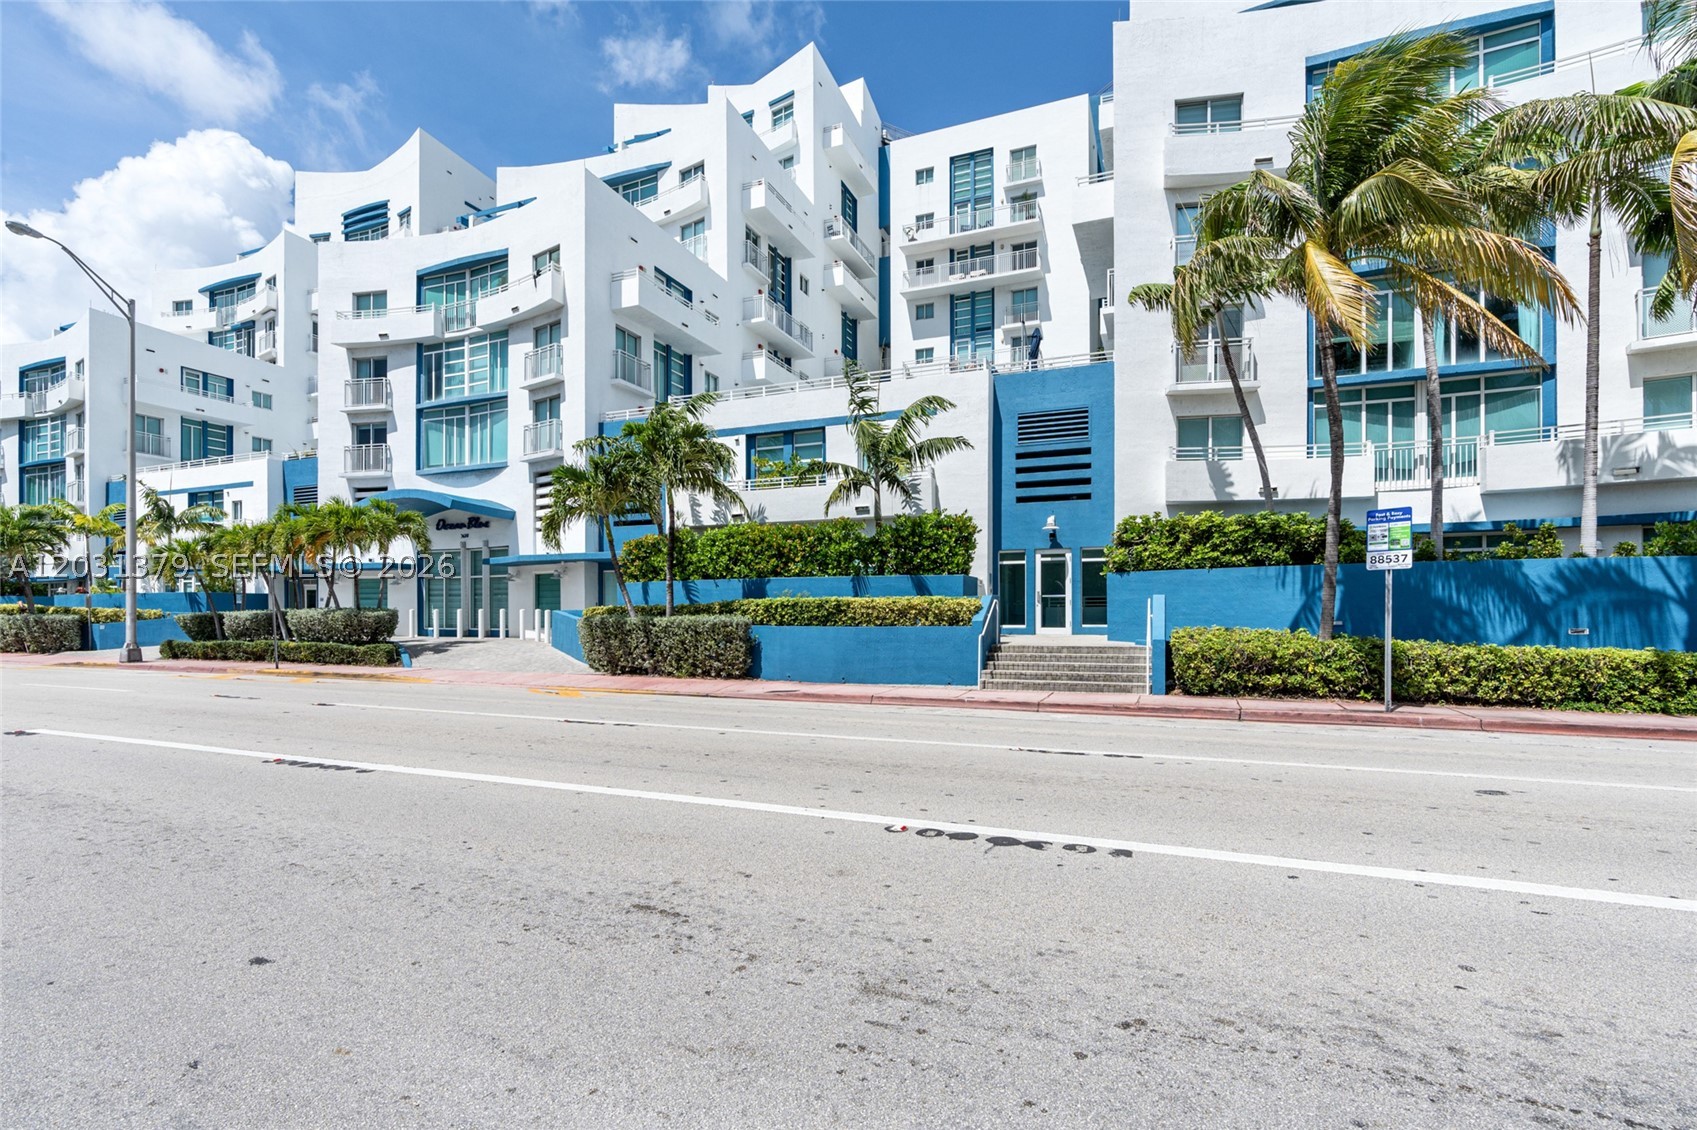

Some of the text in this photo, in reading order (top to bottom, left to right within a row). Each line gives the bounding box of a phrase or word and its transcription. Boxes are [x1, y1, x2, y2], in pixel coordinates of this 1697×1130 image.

[436, 516, 490, 531] Ocean Blue
[1370, 554, 1408, 564] 88537
